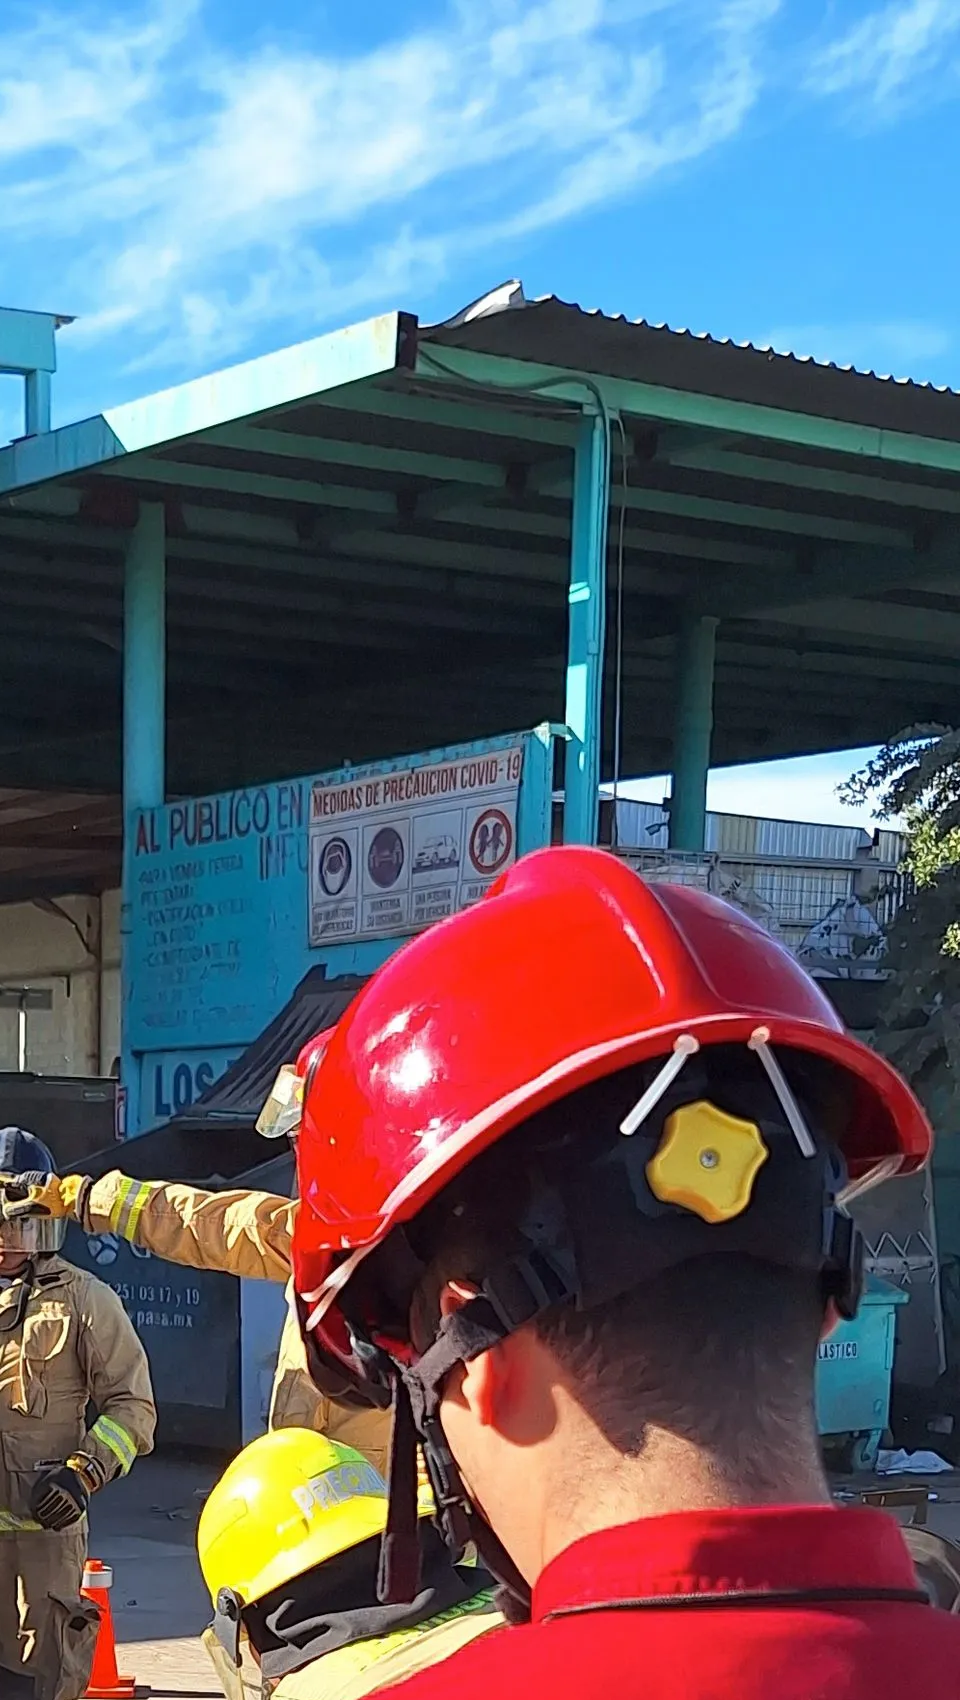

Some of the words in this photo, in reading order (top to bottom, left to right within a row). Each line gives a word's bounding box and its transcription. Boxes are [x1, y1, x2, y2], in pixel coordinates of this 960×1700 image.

[313, 787, 362, 817] MEDIDAS
[366, 784, 379, 806] DE
[136, 811, 161, 856] AL
[278, 784, 302, 829] EN
[155, 1062, 214, 1116] LOS
[140, 1286, 154, 1302] 03
[160, 1287, 171, 1303] 17
[186, 1288, 200, 1305] 19
[818, 1342, 857, 1359] LASTICO
